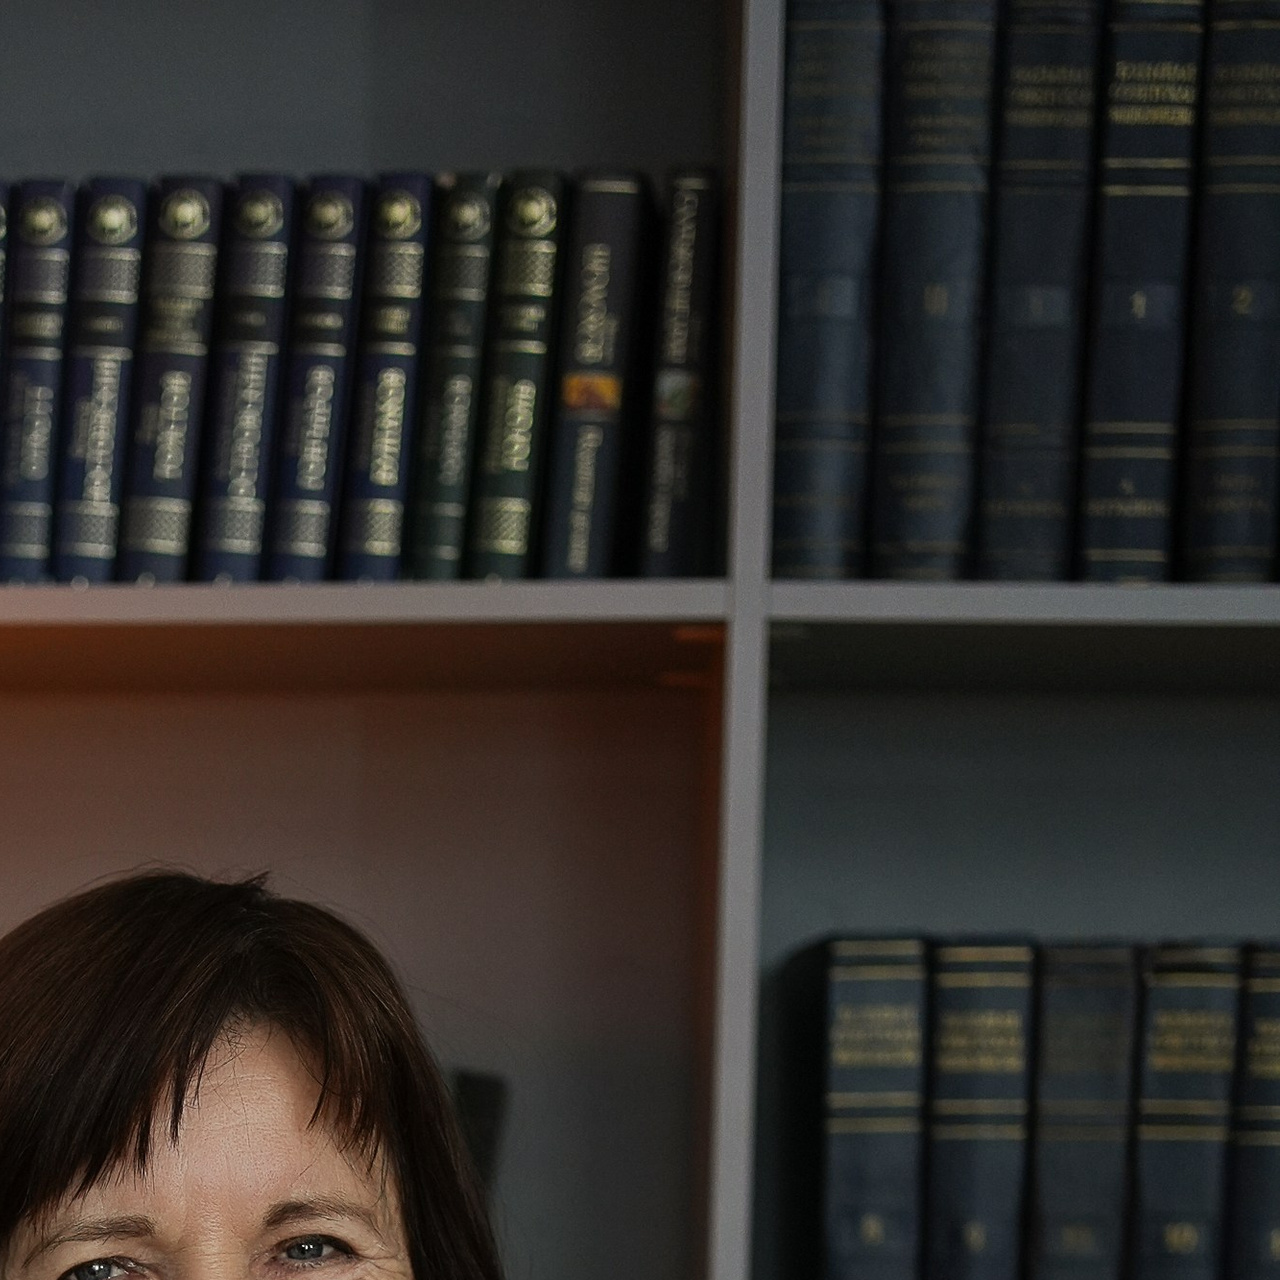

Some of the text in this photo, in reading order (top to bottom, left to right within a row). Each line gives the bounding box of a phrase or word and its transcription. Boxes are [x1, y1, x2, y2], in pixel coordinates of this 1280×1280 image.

[21, 386, 54, 480] ОЛКОТТ
[83, 360, 122, 503] ДОСТОЕВСКИЙ
[153, 370, 192, 480] ТОЛСТОЙ
[228, 355, 269, 498] ОСТРОВСКИЙ
[297, 365, 335, 491] ГОНЧАРОВ
[370, 367, 406, 487] БУЛГАКОВ
[502, 379, 536, 471] ГОГОЛЬ
